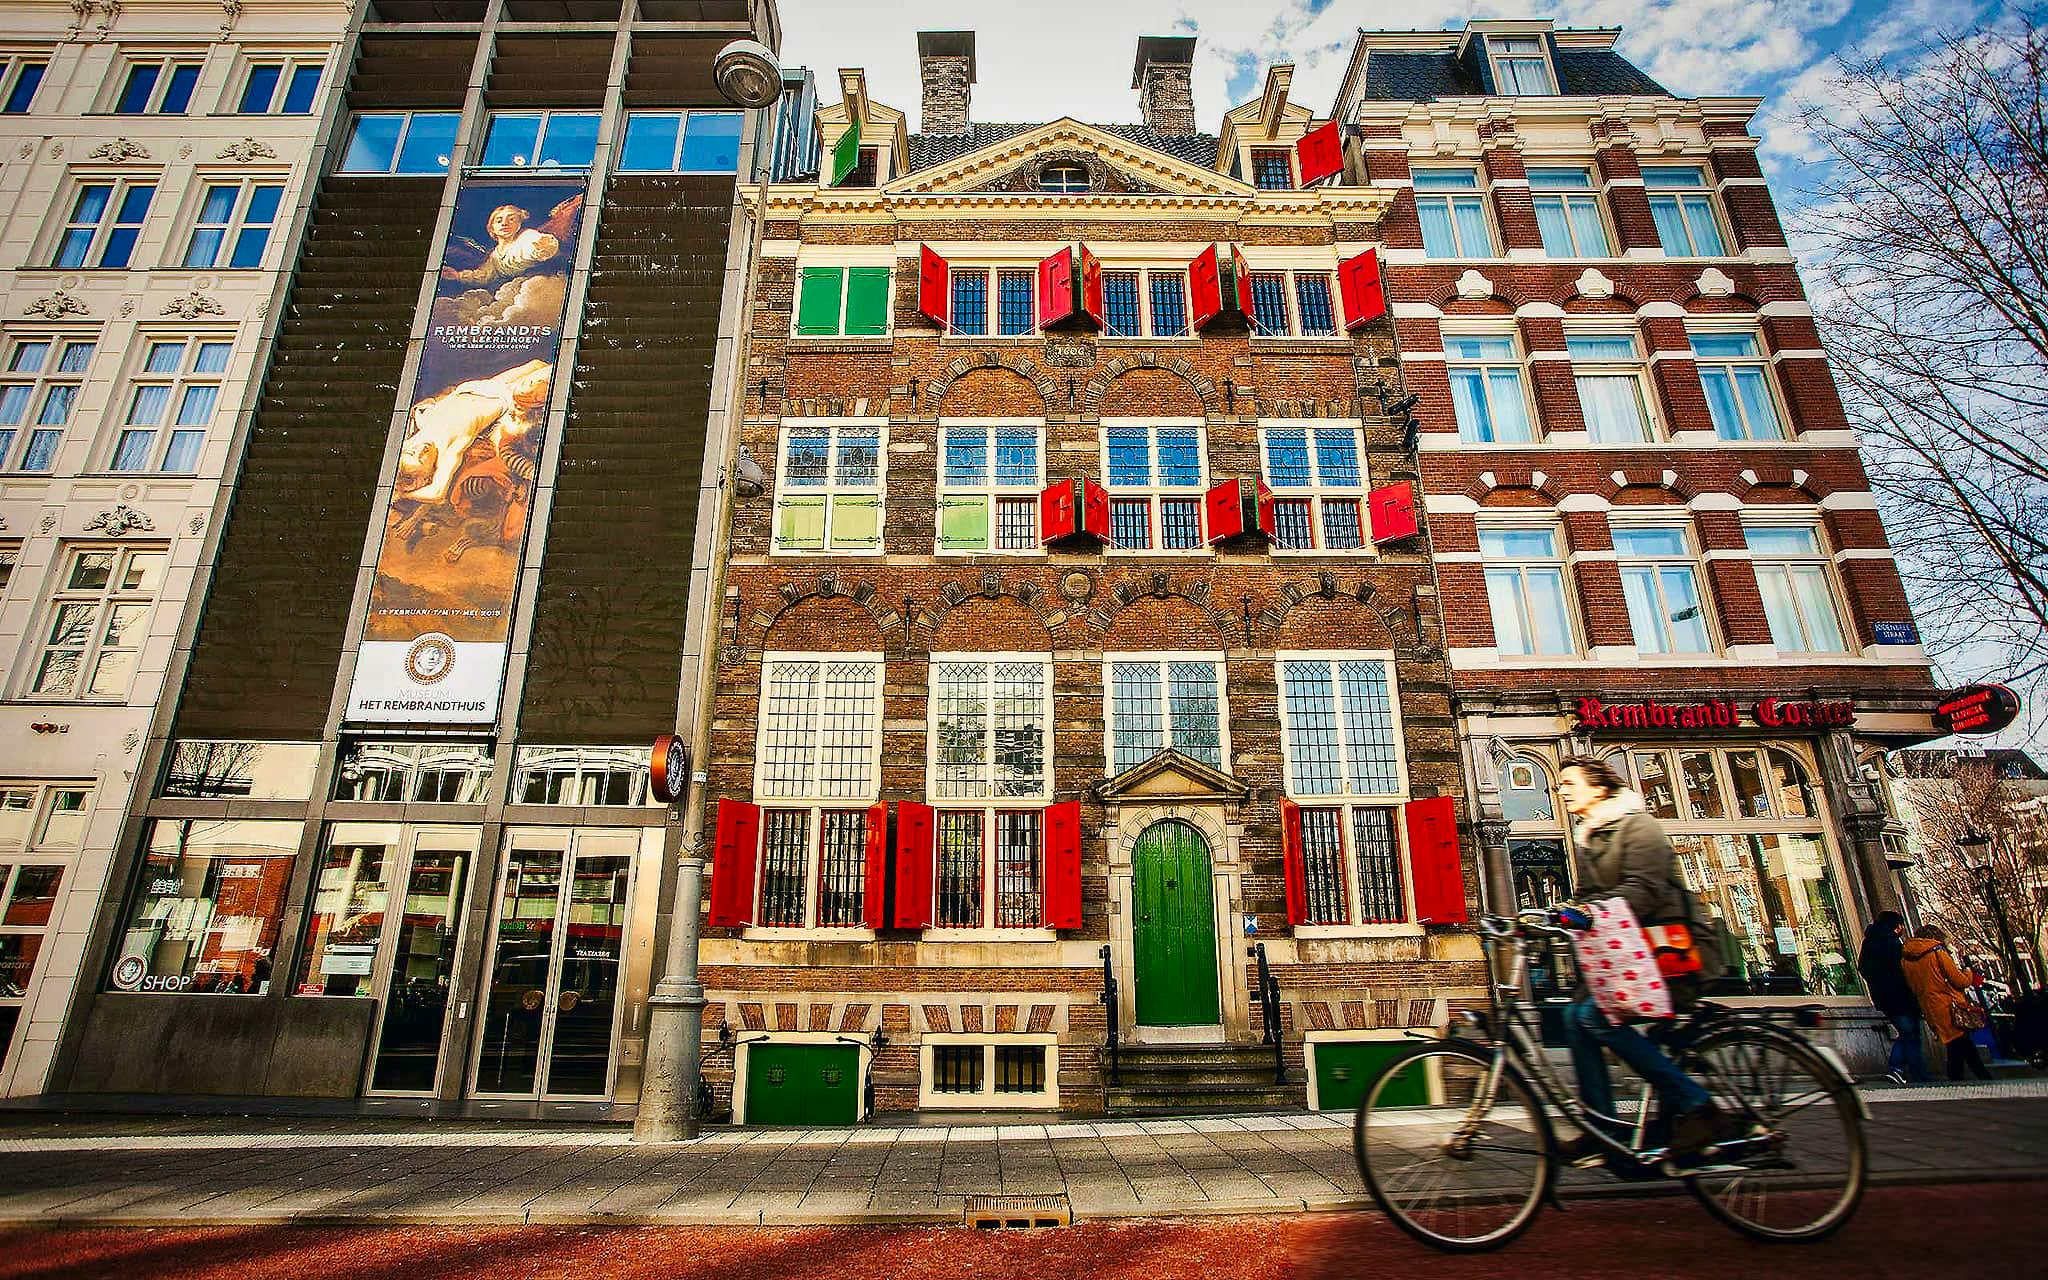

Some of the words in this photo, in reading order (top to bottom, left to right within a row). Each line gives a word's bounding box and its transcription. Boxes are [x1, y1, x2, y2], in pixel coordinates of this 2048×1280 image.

[434, 325, 551, 336] REMBRANDTS
[442, 335, 467, 343] LATE
[472, 335, 540, 343] LEERLINGEN
[397, 688, 451, 700] MUSEUM
[359, 700, 383, 710] HET
[383, 700, 486, 711] REMBRANDTHUIS
[1576, 696, 1741, 728] Rembrandt
[1754, 696, 1857, 728] Corner
[1951, 703, 1985, 721] LUNCH
[1951, 713, 1990, 731] DINNER
[143, 975, 191, 991] SHOP
